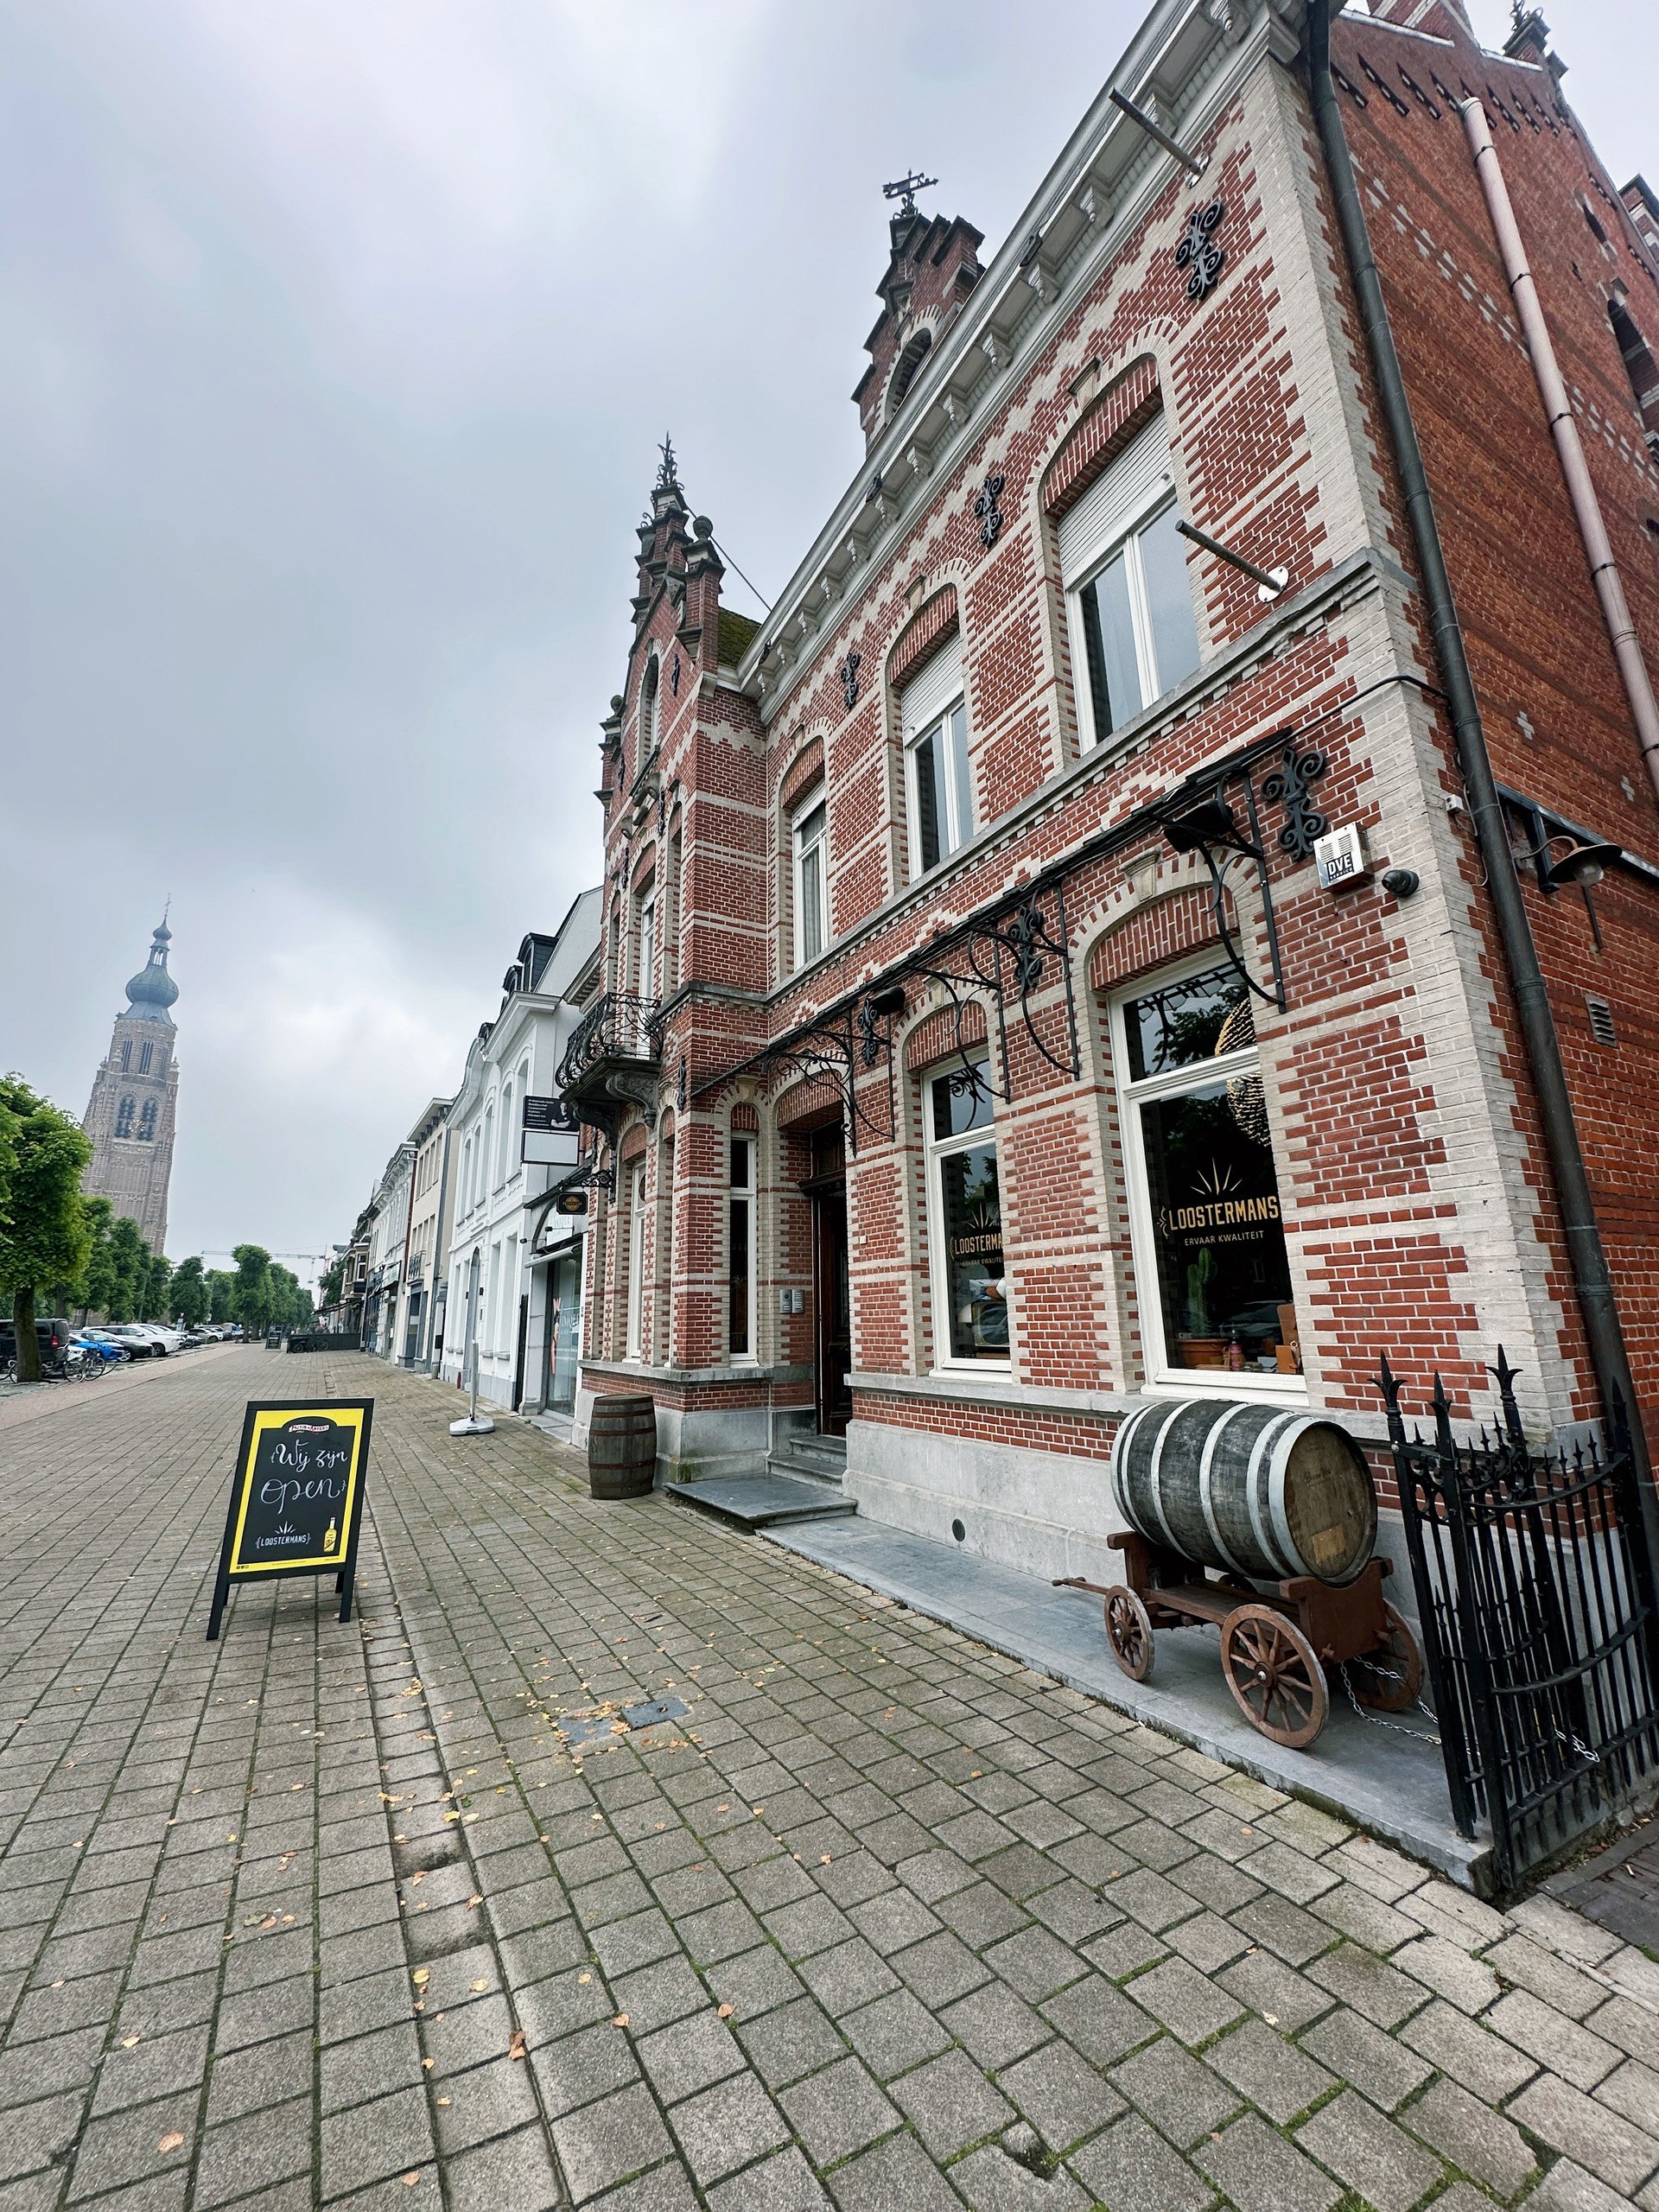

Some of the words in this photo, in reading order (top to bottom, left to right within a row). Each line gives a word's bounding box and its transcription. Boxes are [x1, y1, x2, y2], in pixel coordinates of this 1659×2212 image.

[1327, 854, 1352, 875] DVE
[1184, 1235, 1216, 1246] ERVAAR
[1218, 1230, 1264, 1243] KWALITEIT
[276, 1439, 310, 1472] Wij
[315, 1449, 347, 1468] zijn
